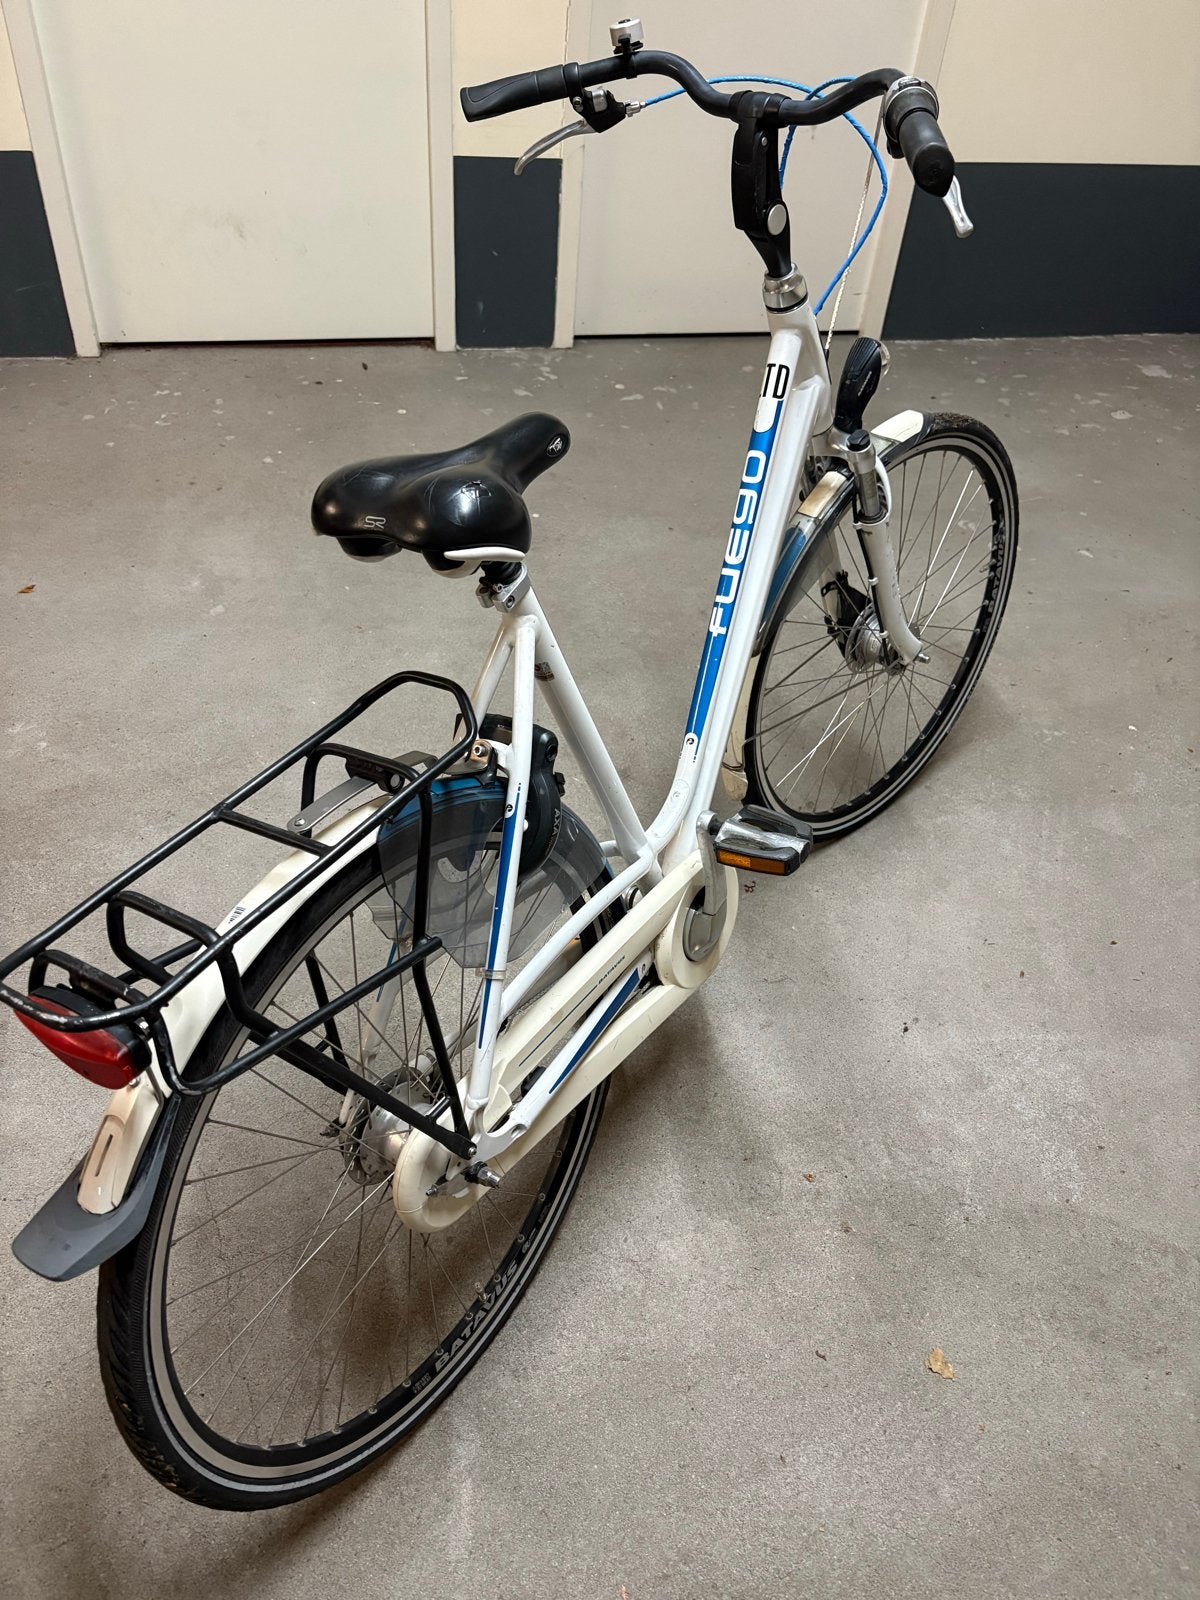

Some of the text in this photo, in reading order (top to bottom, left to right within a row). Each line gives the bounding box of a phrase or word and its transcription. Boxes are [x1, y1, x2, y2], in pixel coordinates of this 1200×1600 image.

[759, 363, 790, 399] TD
[552, 808, 561, 836] AXA
[435, 1259, 518, 1373] BATAVUS
